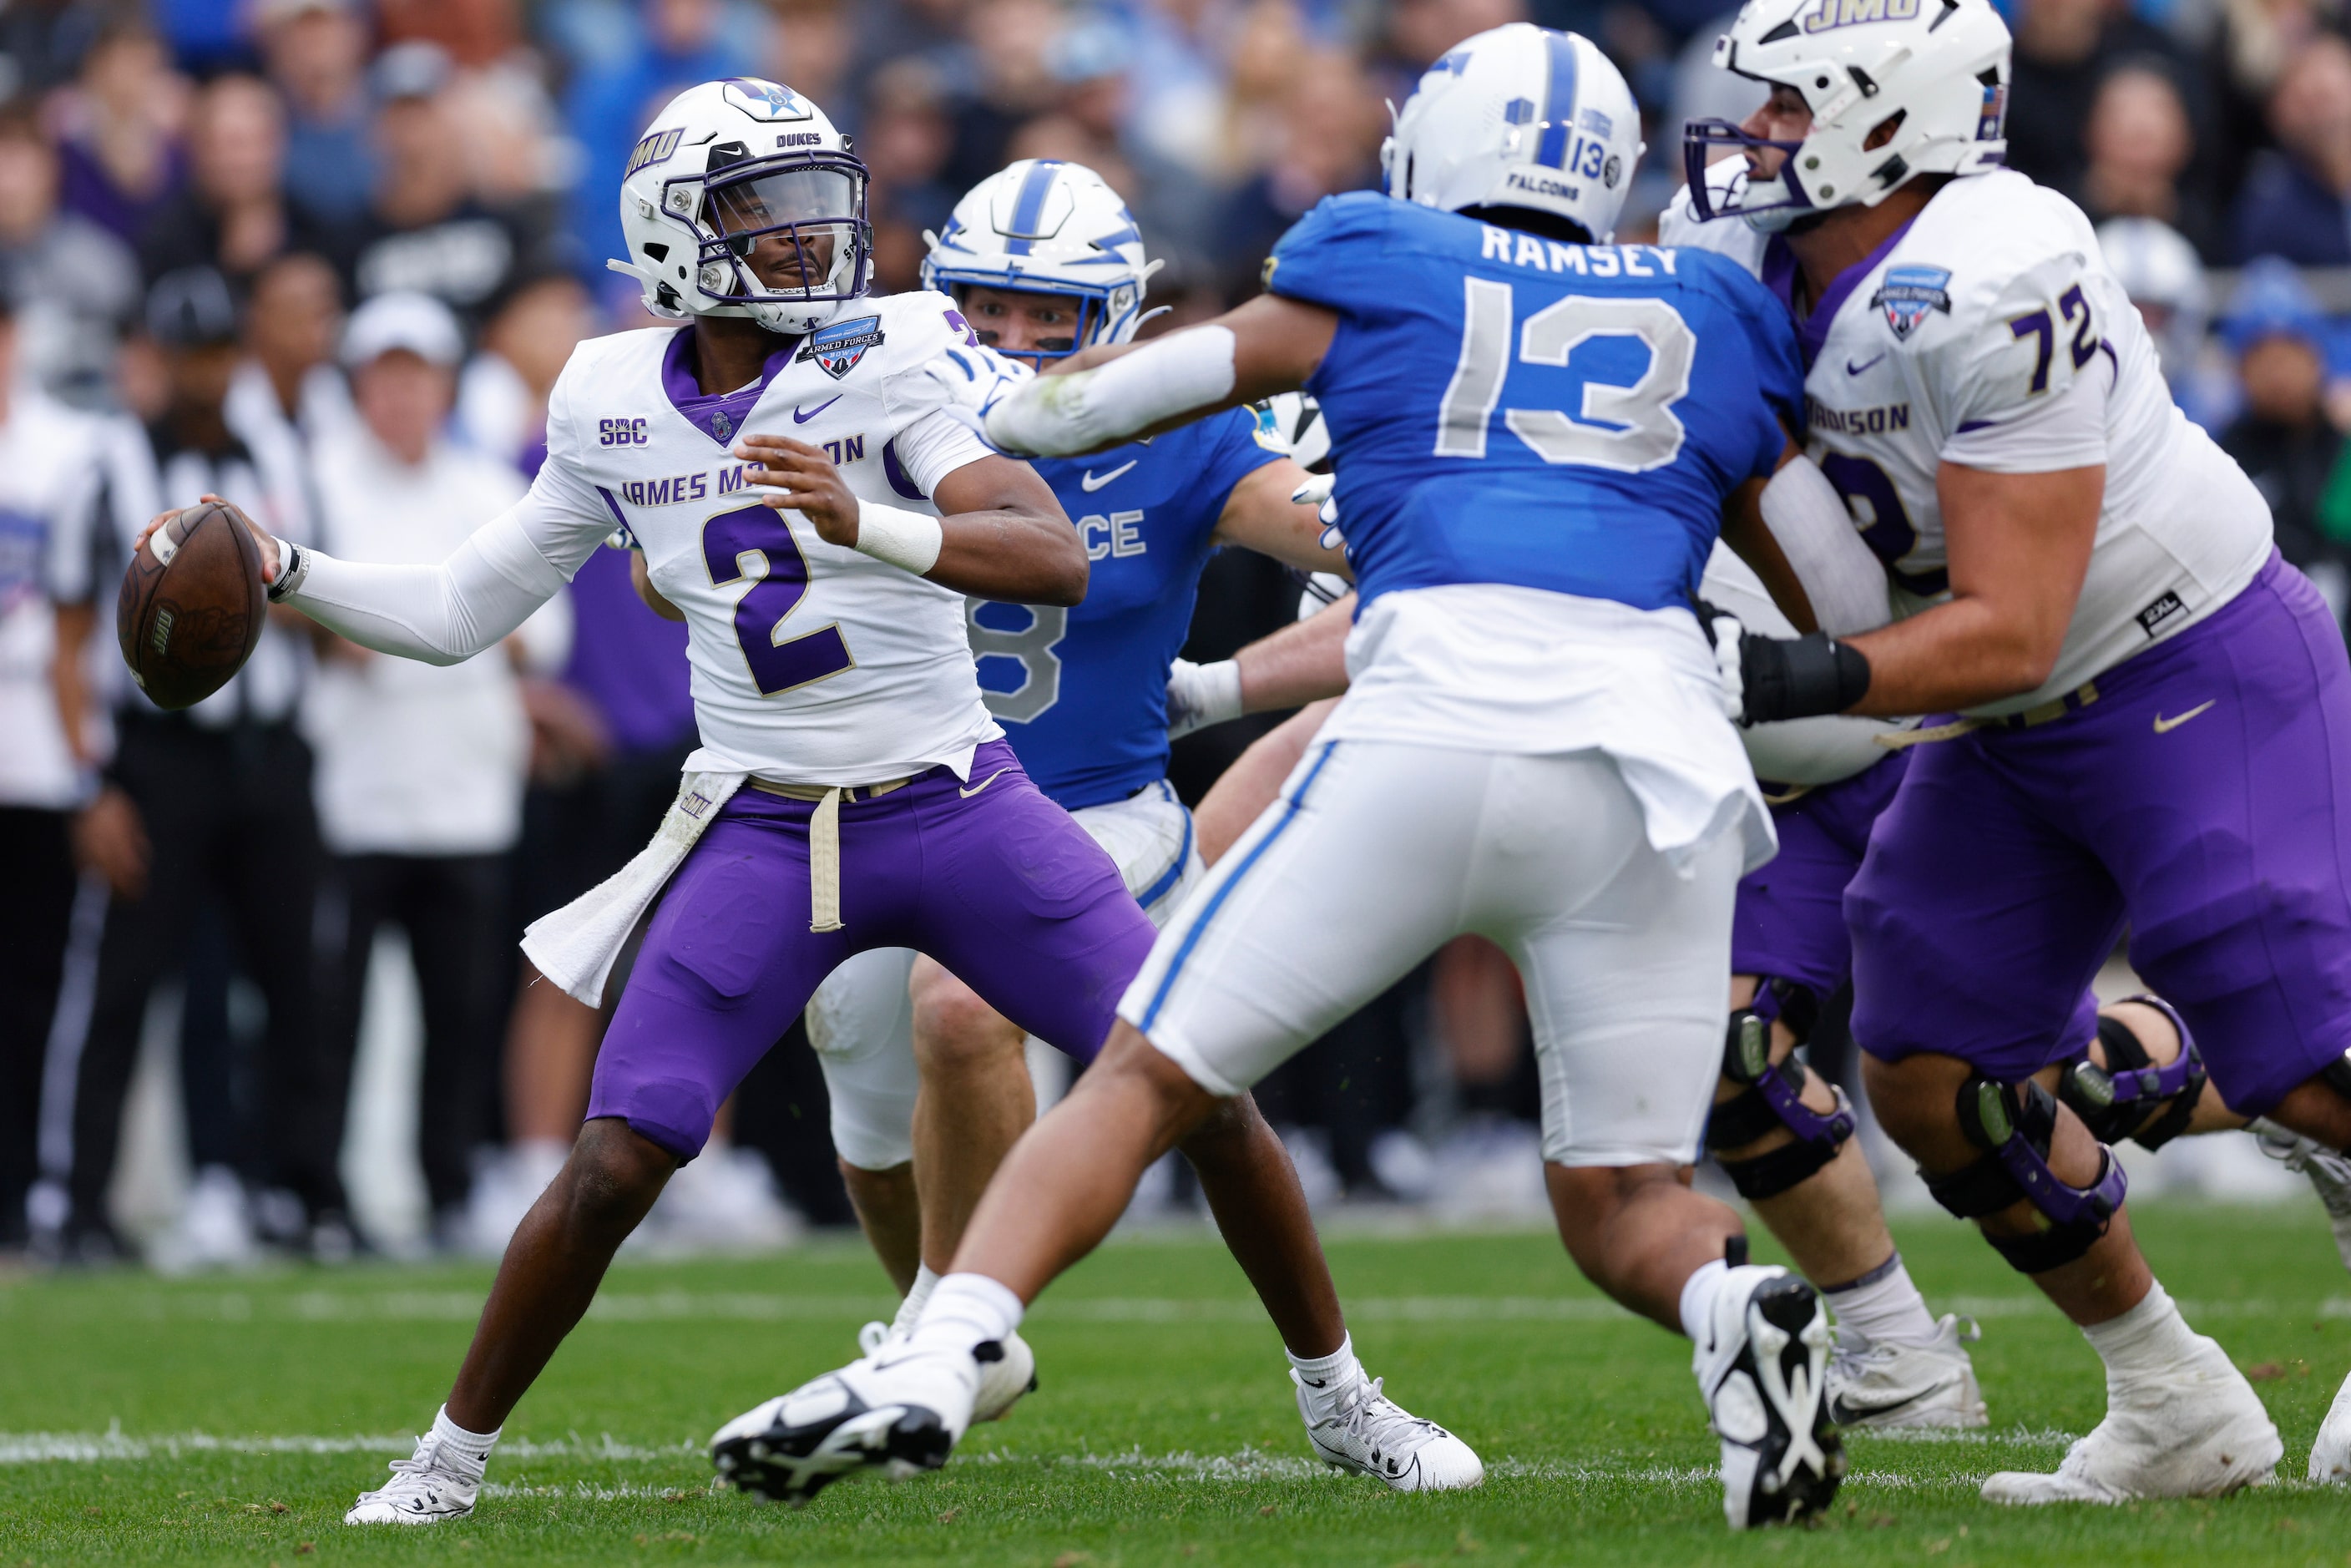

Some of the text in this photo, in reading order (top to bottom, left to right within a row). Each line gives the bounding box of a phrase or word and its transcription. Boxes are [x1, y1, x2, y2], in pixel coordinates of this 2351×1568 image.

[1804, 0, 1920, 33] JMU
[776, 132, 822, 148] DUKES
[1570, 138, 1604, 180] 13
[1507, 173, 1580, 201] FALCONS
[1481, 225, 1676, 276] RAMSEY
[806, 332, 879, 355] ARMED FORCES
[829, 349, 856, 358] BOWL
[2006, 281, 2098, 398] 72
[1433, 275, 1696, 473] 13
[599, 417, 648, 445] SBC
[700, 501, 857, 699] 2
[2143, 598, 2178, 625] 2XL
